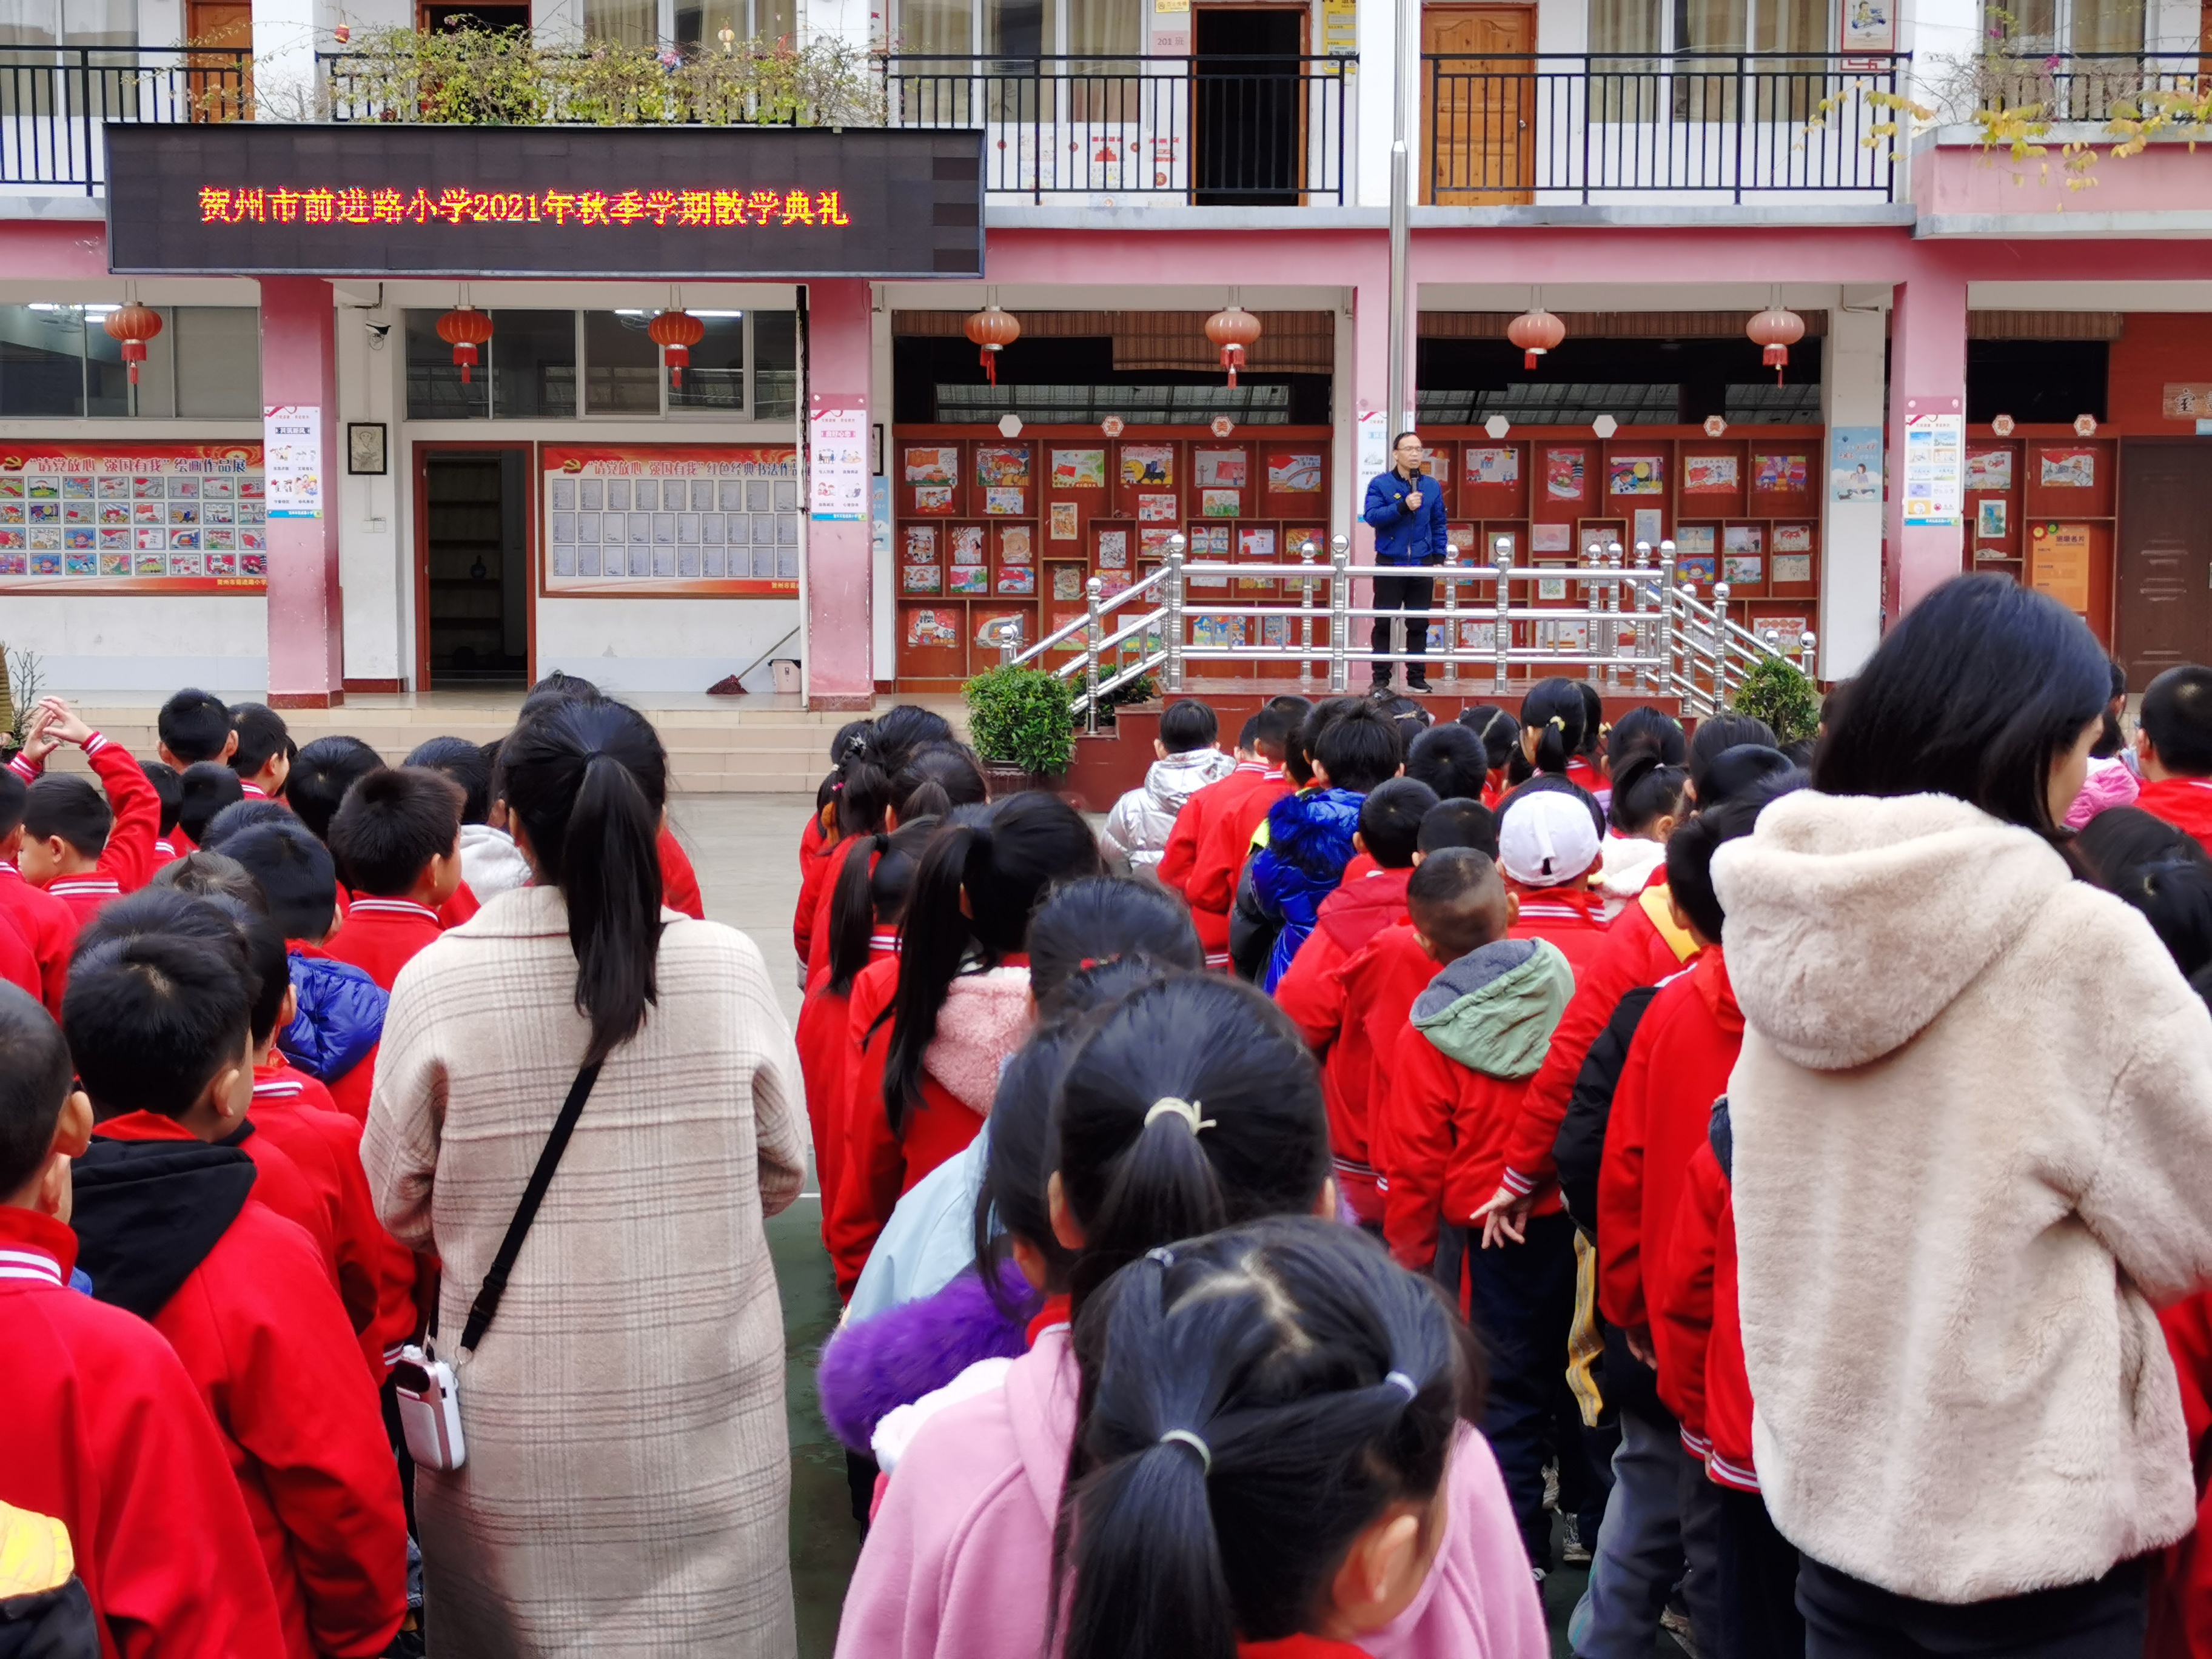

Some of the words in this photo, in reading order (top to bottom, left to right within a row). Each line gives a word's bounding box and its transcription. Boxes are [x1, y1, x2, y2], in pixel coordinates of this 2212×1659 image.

[1175, 36, 1184, 45] 班
[198, 184, 851, 227] 贺州市前进路小学2021年秋季学期散学典礼
[1107, 421, 1119, 432] 造
[1216, 421, 1228, 432] 美
[1709, 421, 1720, 432] 美
[2080, 420, 2091, 431] 美
[649, 460, 810, 477] 强国有我”红色经典书法作品
